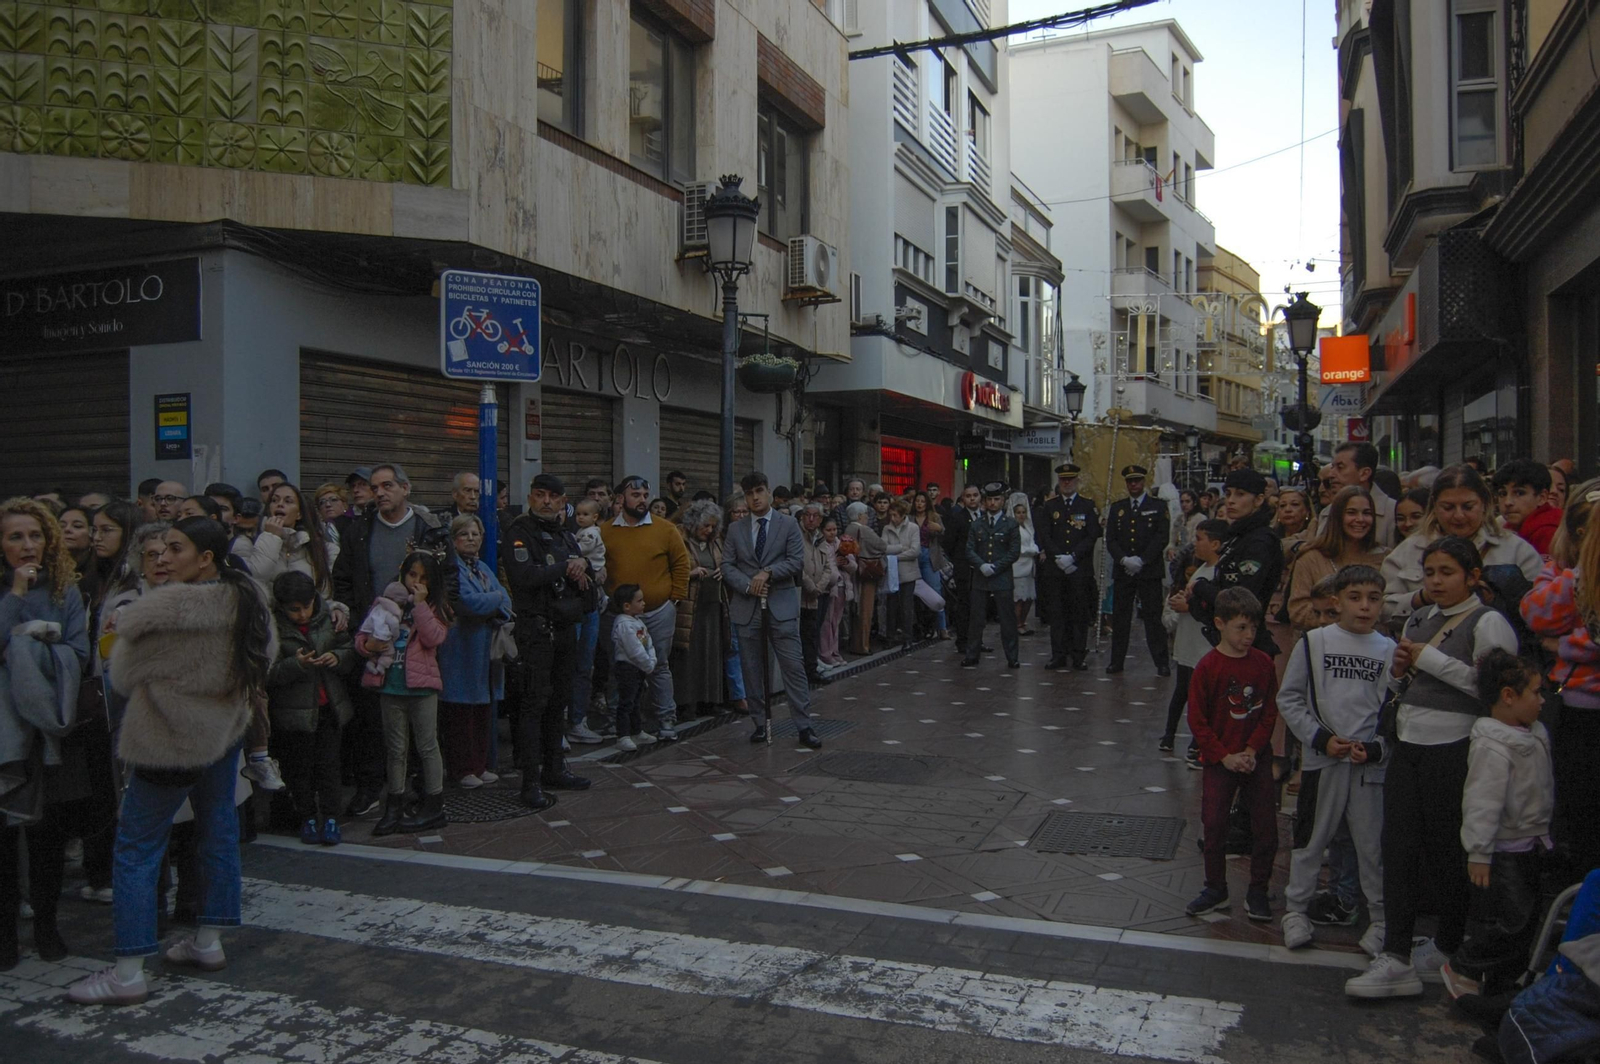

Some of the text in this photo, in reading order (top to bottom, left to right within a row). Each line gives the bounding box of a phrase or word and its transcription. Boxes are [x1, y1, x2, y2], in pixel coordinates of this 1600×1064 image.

[448, 275, 537, 290] ZONA PEATONAL
[448, 284, 486, 293] PROHIBIDO
[487, 287, 521, 296] CIRCULAR
[36, 275, 163, 313] BARTOLO
[448, 292, 489, 302] BICICLETAS
[501, 297, 537, 307] PATINETES
[88, 318, 124, 335] Sonido
[466, 361, 500, 370] SANCIÓN
[501, 363, 514, 371] 200
[541, 336, 671, 402] ARTOLO
[1322, 370, 1365, 381] orange
[1027, 437, 1056, 445] MOBILE
[1323, 655, 1385, 676] STRANGER
[1332, 667, 1376, 683] THINGS
